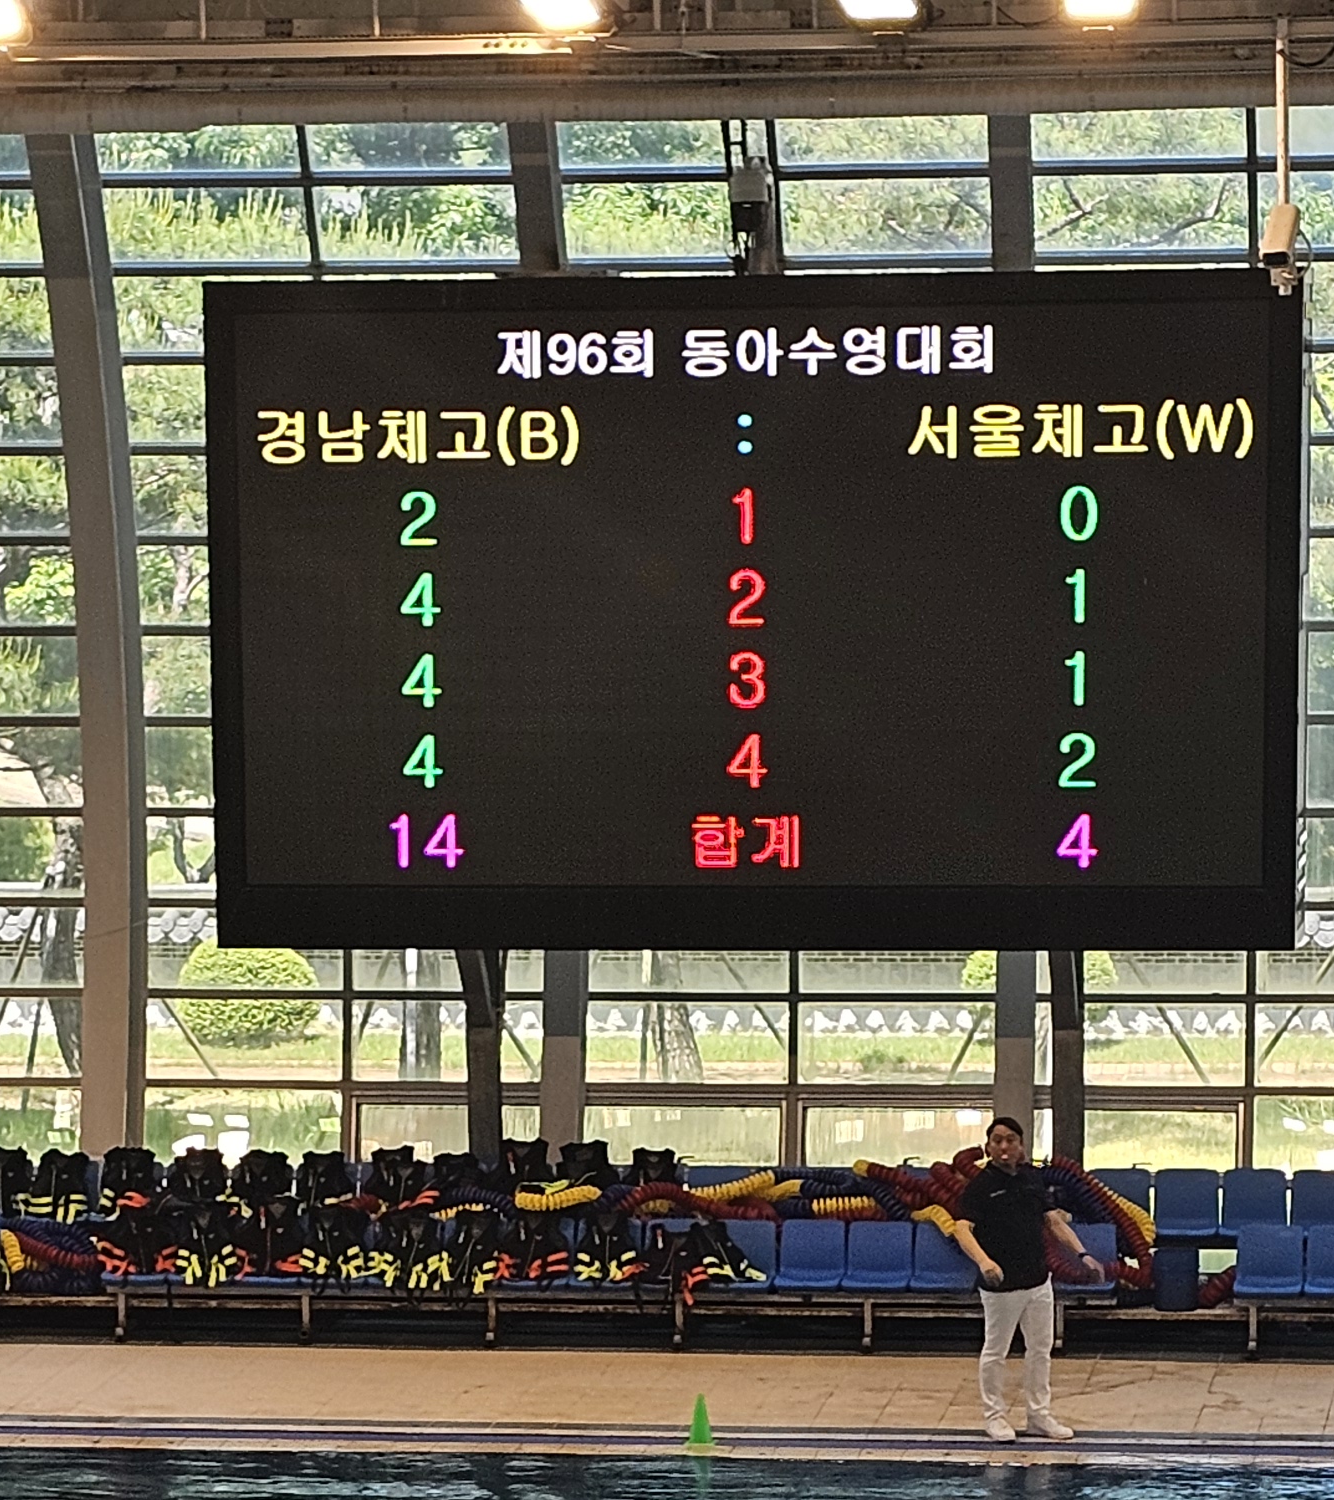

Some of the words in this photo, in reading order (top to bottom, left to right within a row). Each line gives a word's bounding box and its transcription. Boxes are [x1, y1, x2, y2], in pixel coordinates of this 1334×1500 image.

[497, 328, 654, 380] 제96회
[681, 324, 995, 378] 동아수영대회
[256, 405, 580, 467] 경남체고(B)
[907, 397, 1255, 460] 서울체고(W)
[400, 491, 438, 546] 2
[731, 487, 755, 545] 1
[1060, 485, 1098, 541] 0
[400, 572, 442, 627] 4
[726, 567, 767, 628] 2
[1065, 568, 1087, 624] 1
[401, 653, 443, 708] 4
[726, 651, 767, 710] 3
[1065, 650, 1087, 707] 1
[402, 734, 444, 789] 4
[726, 733, 769, 789] 4
[1058, 732, 1097, 788] 2
[389, 813, 466, 869] 14
[691, 814, 803, 869] 합계
[1056, 813, 1099, 869] 4
